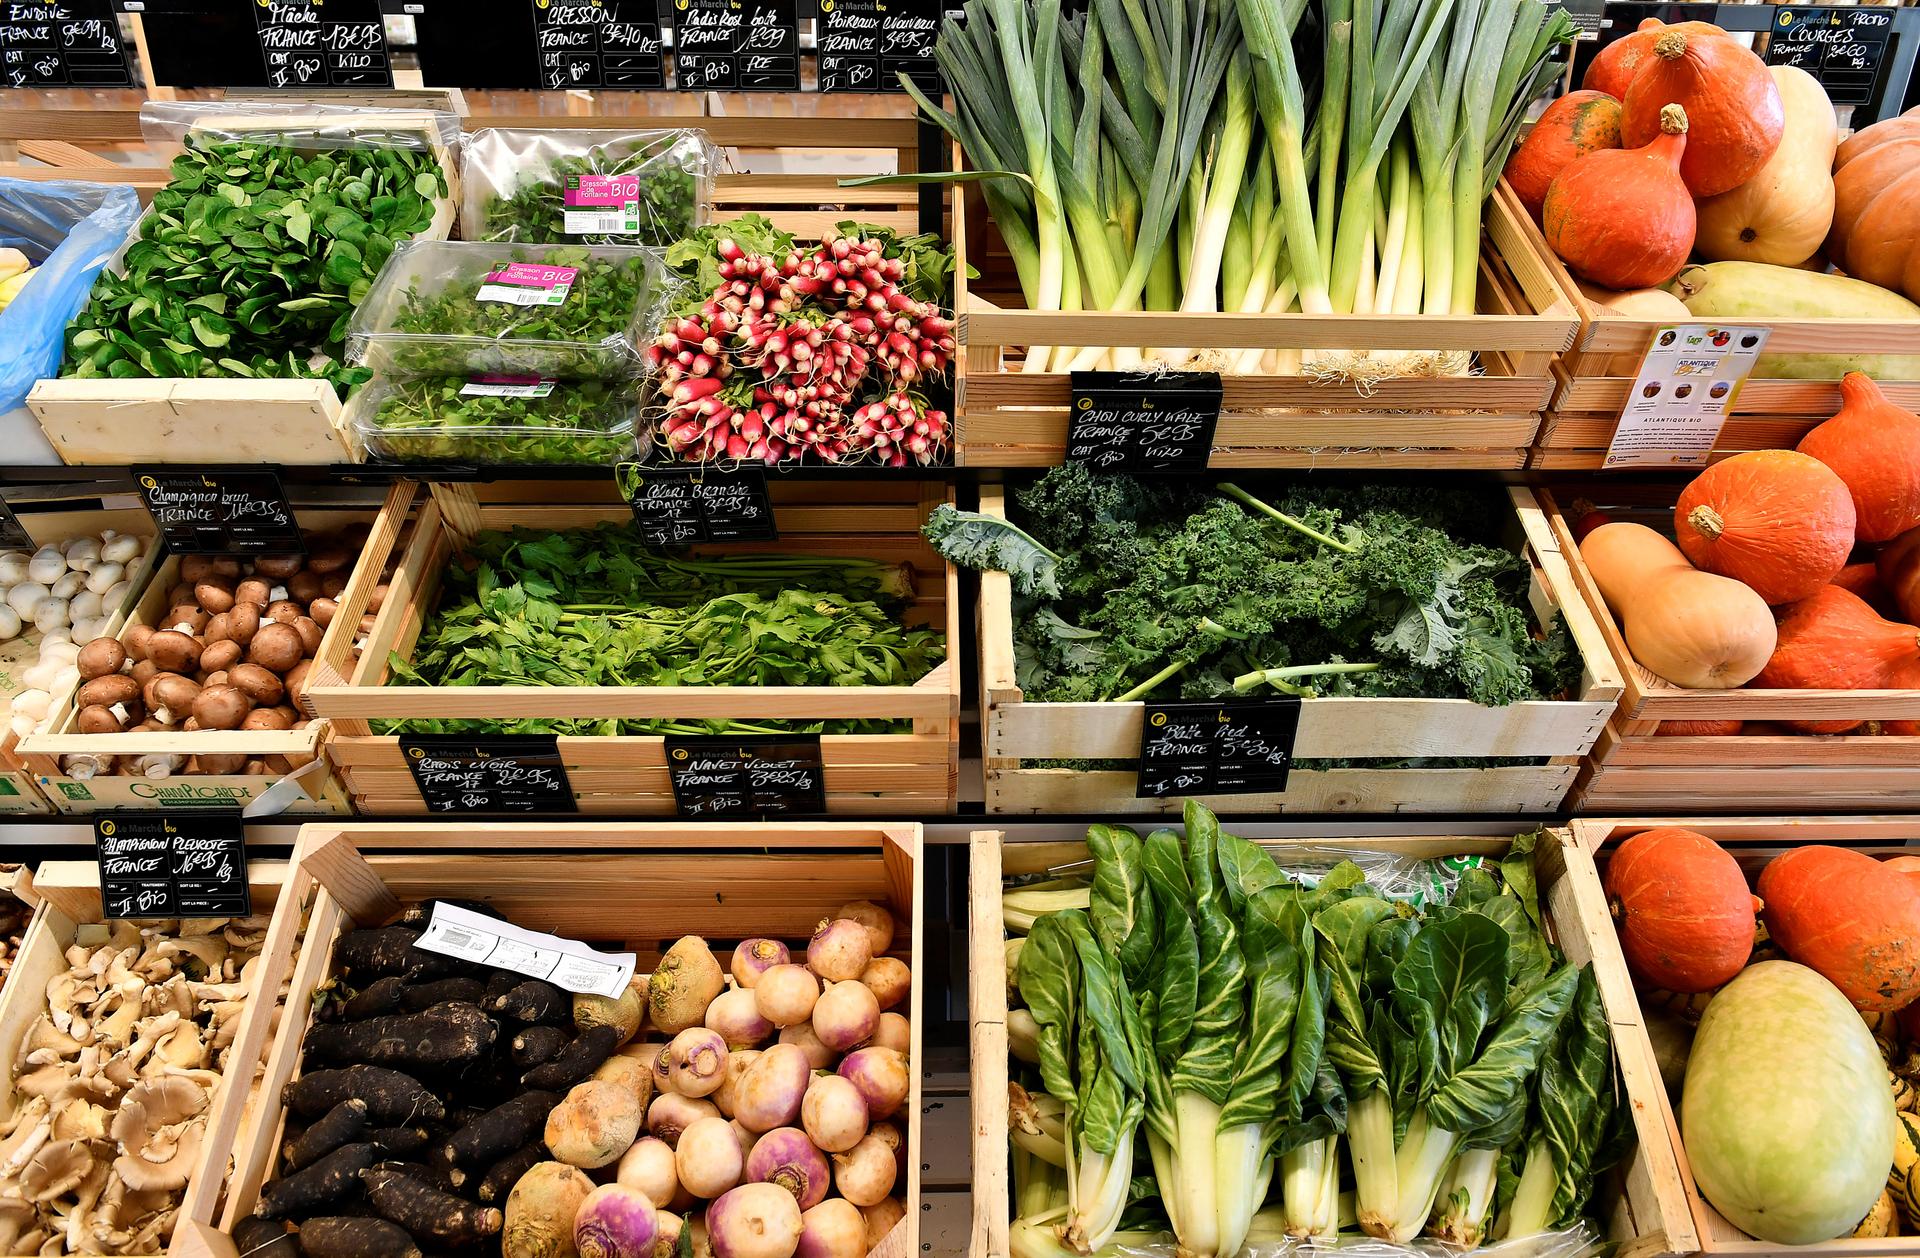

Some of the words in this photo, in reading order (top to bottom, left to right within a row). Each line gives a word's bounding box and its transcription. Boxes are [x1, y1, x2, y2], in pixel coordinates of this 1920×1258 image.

[268, 2, 320, 24] Mâche
[834, 2, 844, 10] Le
[845, 1, 874, 10] Marché
[547, 3, 620, 25] CRESSON
[0, 26, 50, 46] FRANCE
[257, 26, 322, 47] FRANCE
[539, 27, 593, 48] FRANCE
[680, 26, 736, 48] FRANCE
[1788, 23, 1855, 43] COURGES
[817, 30, 877, 52] FRANCE
[1772, 43, 1814, 55] FRANCE
[5, 51, 23, 63] CAT
[270, 52, 290, 65] CAT
[545, 51, 562, 67] CAT
[680, 55, 701, 68] CAT
[611, 183, 638, 197] BIO
[541, 271, 575, 281] BIO
[1678, 359, 1717, 367] ATLANTIQUE
[1142, 397, 1155, 409] bio
[1078, 410, 1120, 423] CHOU
[1121, 410, 1164, 424] CURLY
[1164, 407, 1216, 424] KALE
[1072, 422, 1136, 440] FRANCE
[1071, 444, 1100, 456] CAT
[149, 486, 218, 508] Champignon
[222, 486, 249, 503] brun
[633, 498, 692, 511] FRANCE
[151, 505, 215, 522] FRANCE
[1218, 710, 1231, 723] bio
[1146, 742, 1212, 757] FRANCE
[688, 759, 742, 772] NAVET
[419, 770, 487, 786] FRANCE
[675, 773, 739, 788] FRANCE
[164, 818, 177, 833] bio
[172, 836, 239, 851] PLEUROTE
[103, 856, 164, 875] FRANCE
[216, 854, 233, 883] kg
